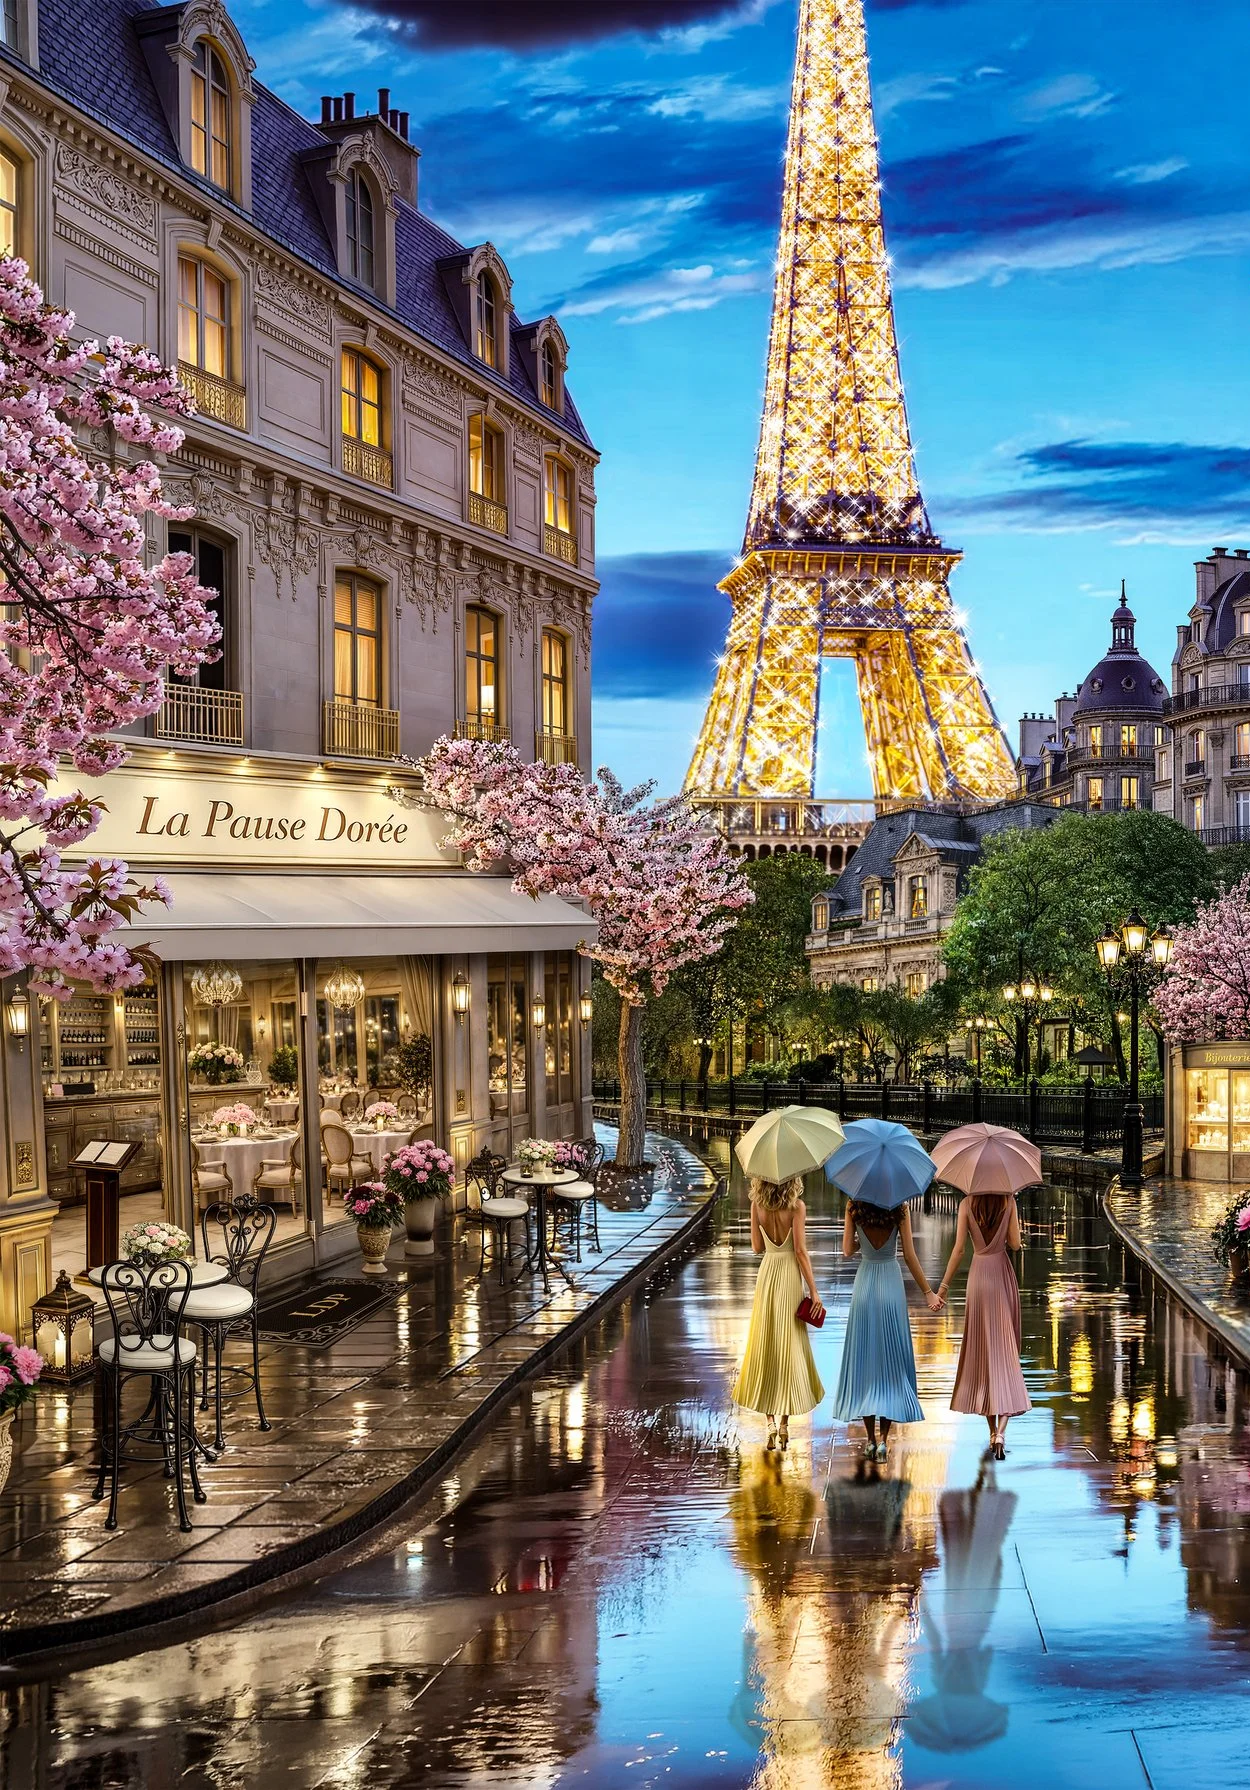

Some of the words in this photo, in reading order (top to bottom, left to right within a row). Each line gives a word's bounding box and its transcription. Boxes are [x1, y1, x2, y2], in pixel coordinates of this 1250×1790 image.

[136, 796, 190, 837] La
[201, 800, 307, 841] Pause
[314, 806, 409, 844] Dorée
[289, 1293, 351, 1318] LDP
